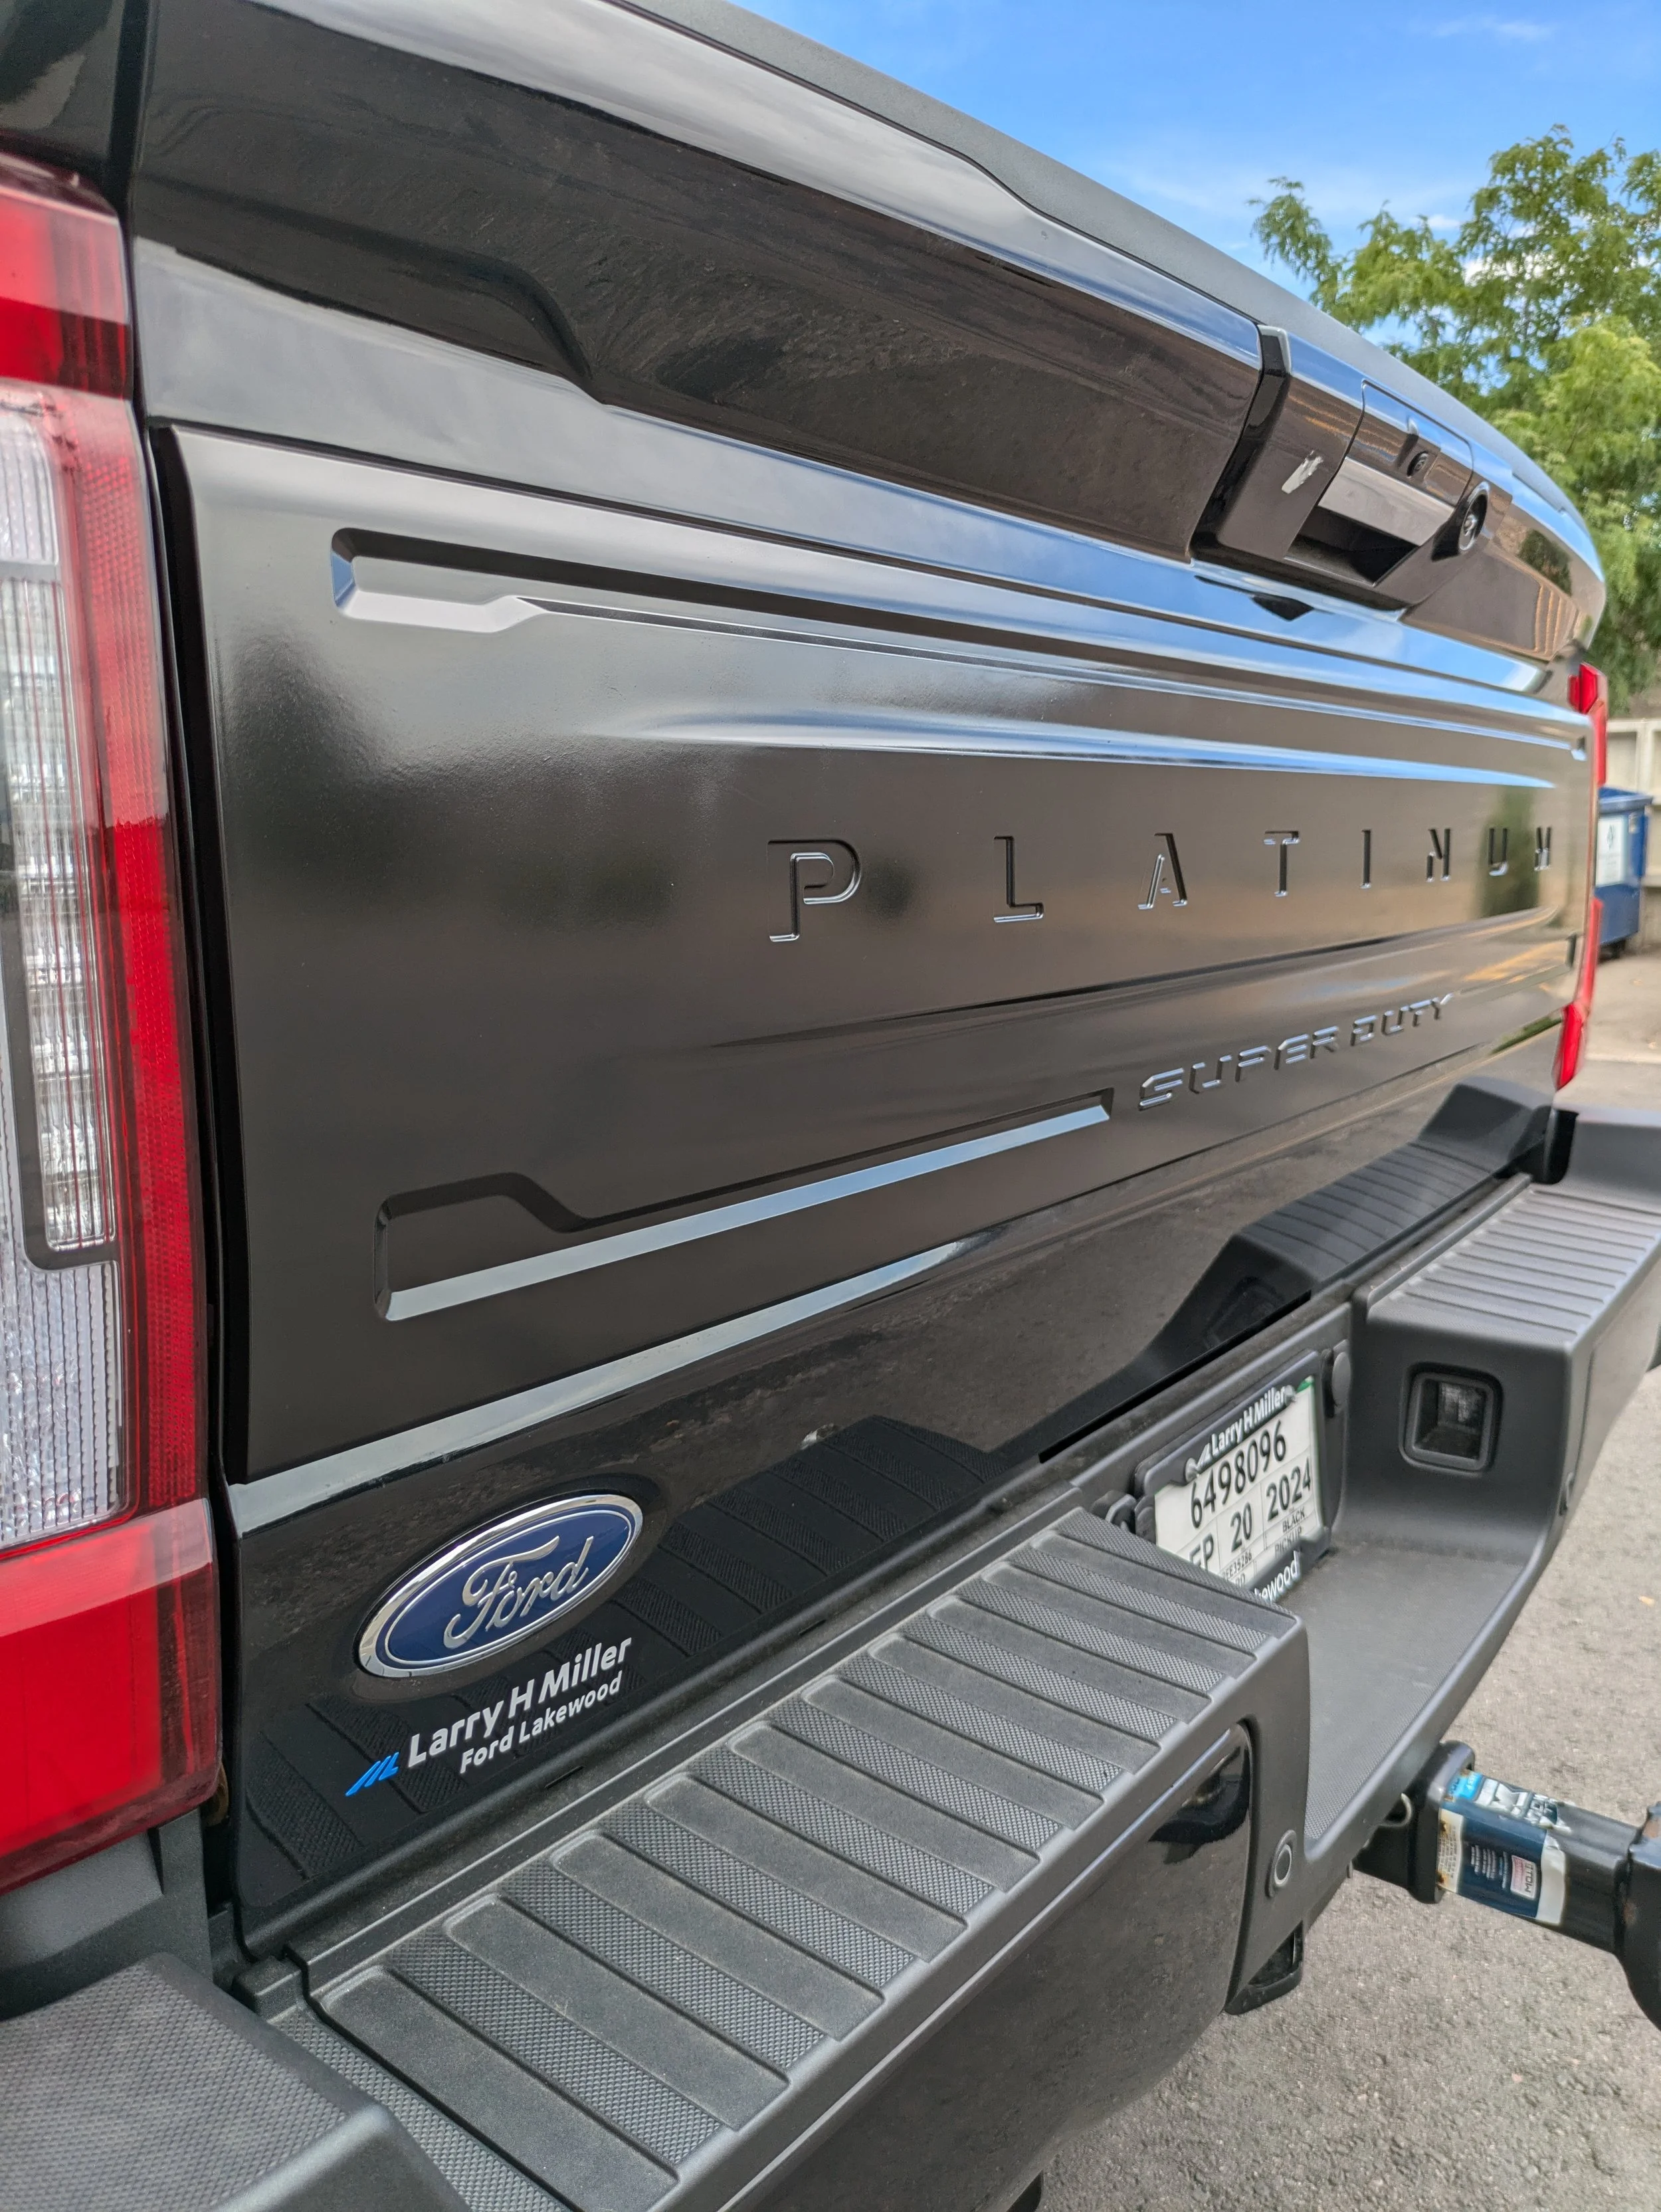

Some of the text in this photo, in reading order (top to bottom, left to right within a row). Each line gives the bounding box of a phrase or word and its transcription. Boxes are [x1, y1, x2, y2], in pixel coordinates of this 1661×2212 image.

[767, 827, 1552, 943] PLATINUM
[1138, 993, 1453, 1112] SUPER DUTY
[1190, 1420, 1286, 1529] 6498096
[1211, 1386, 1286, 1457] Larry H Miller
[1230, 1502, 1252, 1552] 20
[1266, 1456, 1312, 1521] 2024
[1282, 1506, 1305, 1533] BLACK
[443, 1535, 594, 1649] Ford
[407, 1637, 633, 1769] Larry H Miller
[460, 1670, 623, 1774] Ford Lakewood
